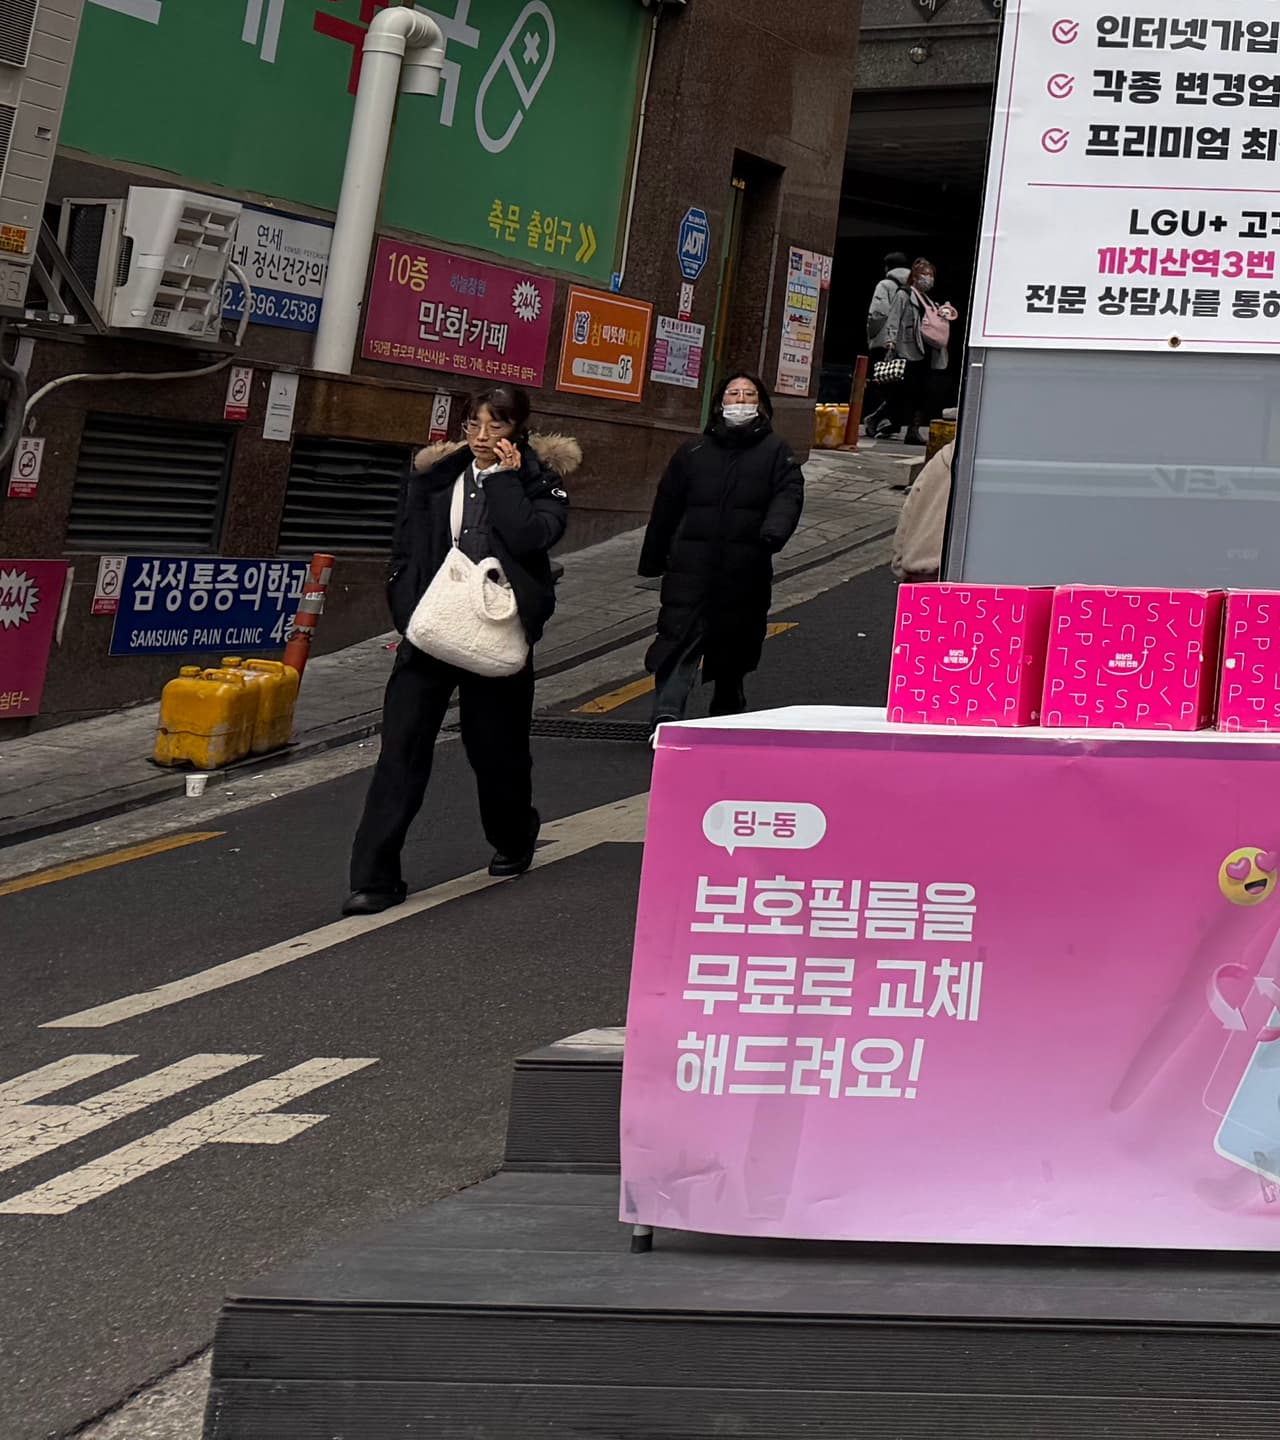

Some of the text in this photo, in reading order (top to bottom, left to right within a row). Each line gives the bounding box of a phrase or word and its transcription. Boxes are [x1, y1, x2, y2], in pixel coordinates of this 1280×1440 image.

[1095, 14, 1280, 54] 인터넷가입
[1092, 69, 1163, 106] 각종
[1084, 123, 1231, 162] 프리미엄
[257, 224, 284, 251] 연세
[487, 199, 573, 255] 측문 출입구
[1128, 208, 1228, 237] LGU+
[683, 231, 706, 257] ADT
[252, 250, 330, 287] 정신건강의
[387, 250, 429, 293] 10층
[1097, 245, 1275, 281] 까치산역3번
[1025, 284, 1087, 316] 전문
[1097, 285, 1220, 319] 상담사를
[418, 300, 509, 355] 만화카페
[130, 627, 263, 647] SAMSUNG PAIN CLINIC
[730, 809, 797, 841] 딩-동
[690, 875, 978, 942] 보호필름을
[681, 953, 985, 1023] 무료로 교체
[675, 1032, 925, 1100] 해드려요!
